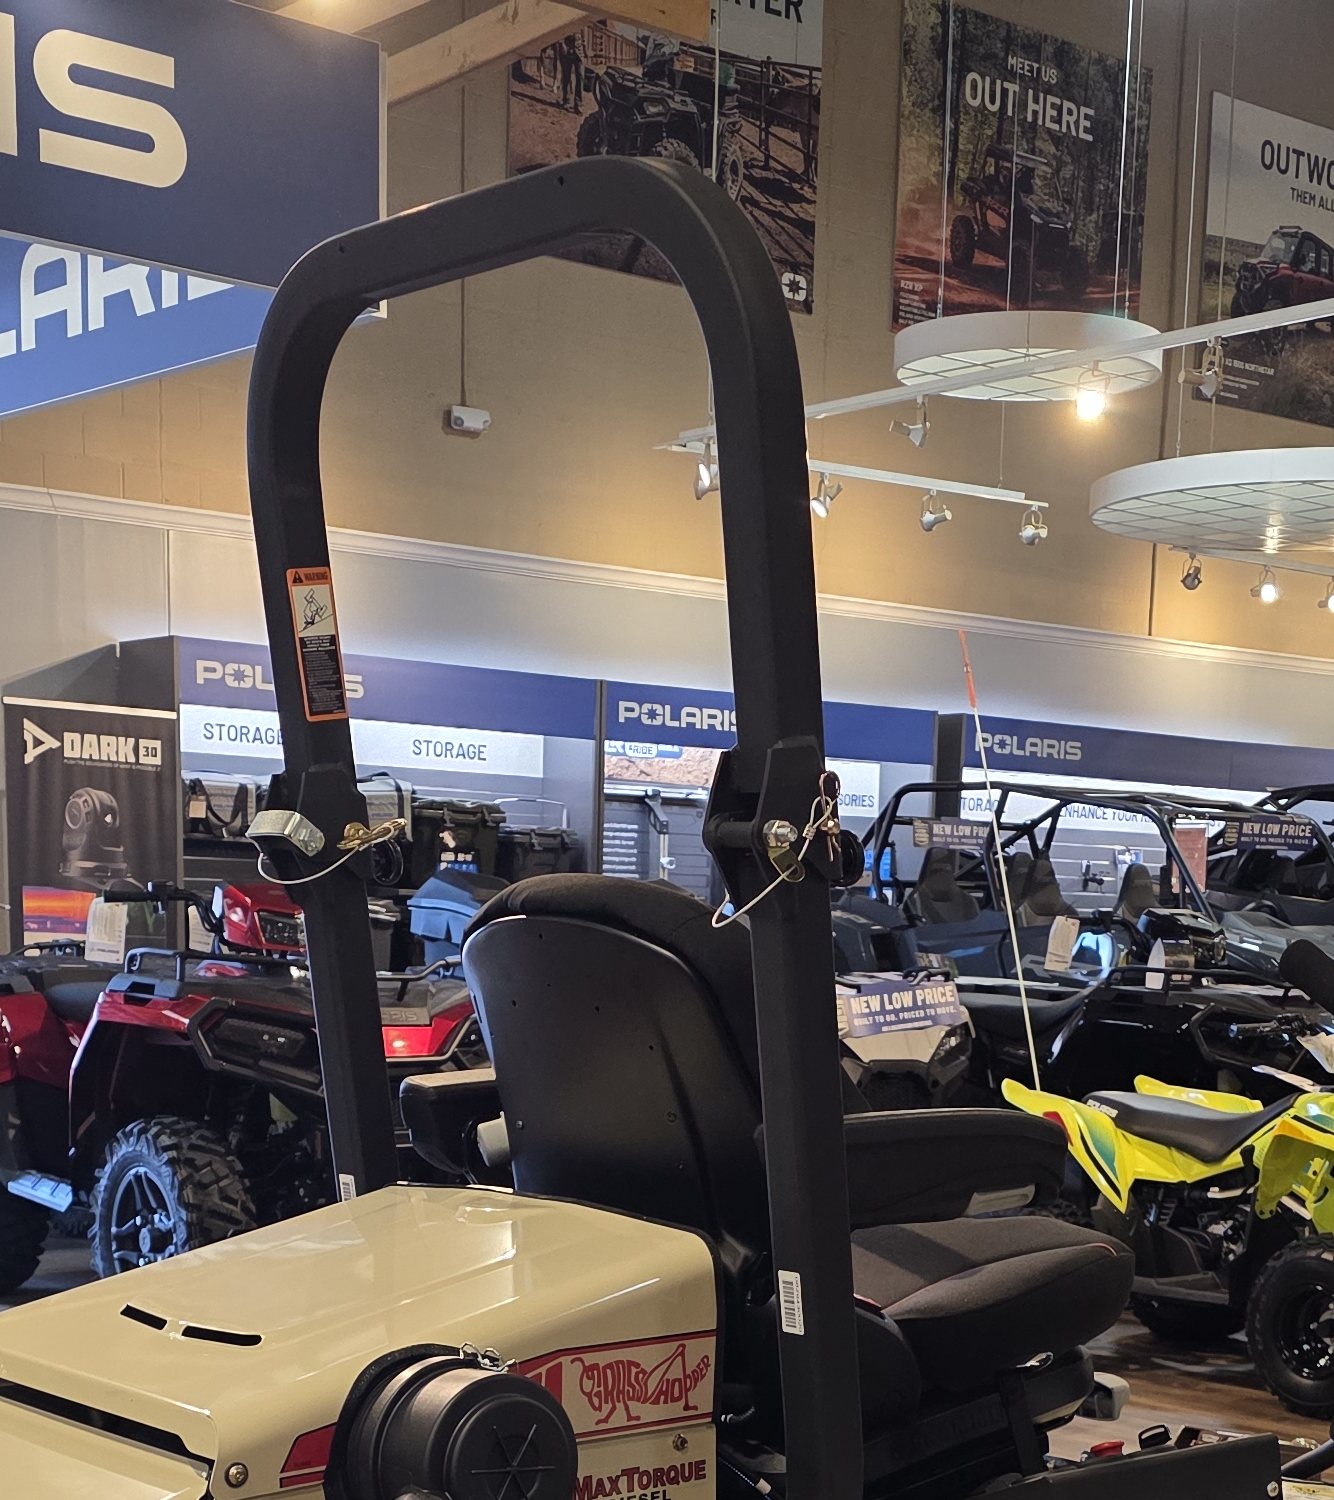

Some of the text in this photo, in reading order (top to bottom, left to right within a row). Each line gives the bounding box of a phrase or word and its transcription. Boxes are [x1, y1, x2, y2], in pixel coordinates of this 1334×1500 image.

[1008, 54, 1058, 84] MEET US
[965, 72, 1095, 141] OUT HERE
[1290, 187, 1316, 207] THEM
[196, 660, 364, 698] POLS
[63, 732, 158, 763] DARK 30
[412, 739, 487, 761] STORAGE
[975, 732, 1082, 761] POLARIS
[933, 824, 952, 835] NEW
[954, 825, 971, 836] LOW
[1242, 822, 1312, 837] NEW LOW PRICE
[850, 985, 955, 1014] NEW LOW PRICE
[571, 1343, 711, 1426] GRASSHOPPER
